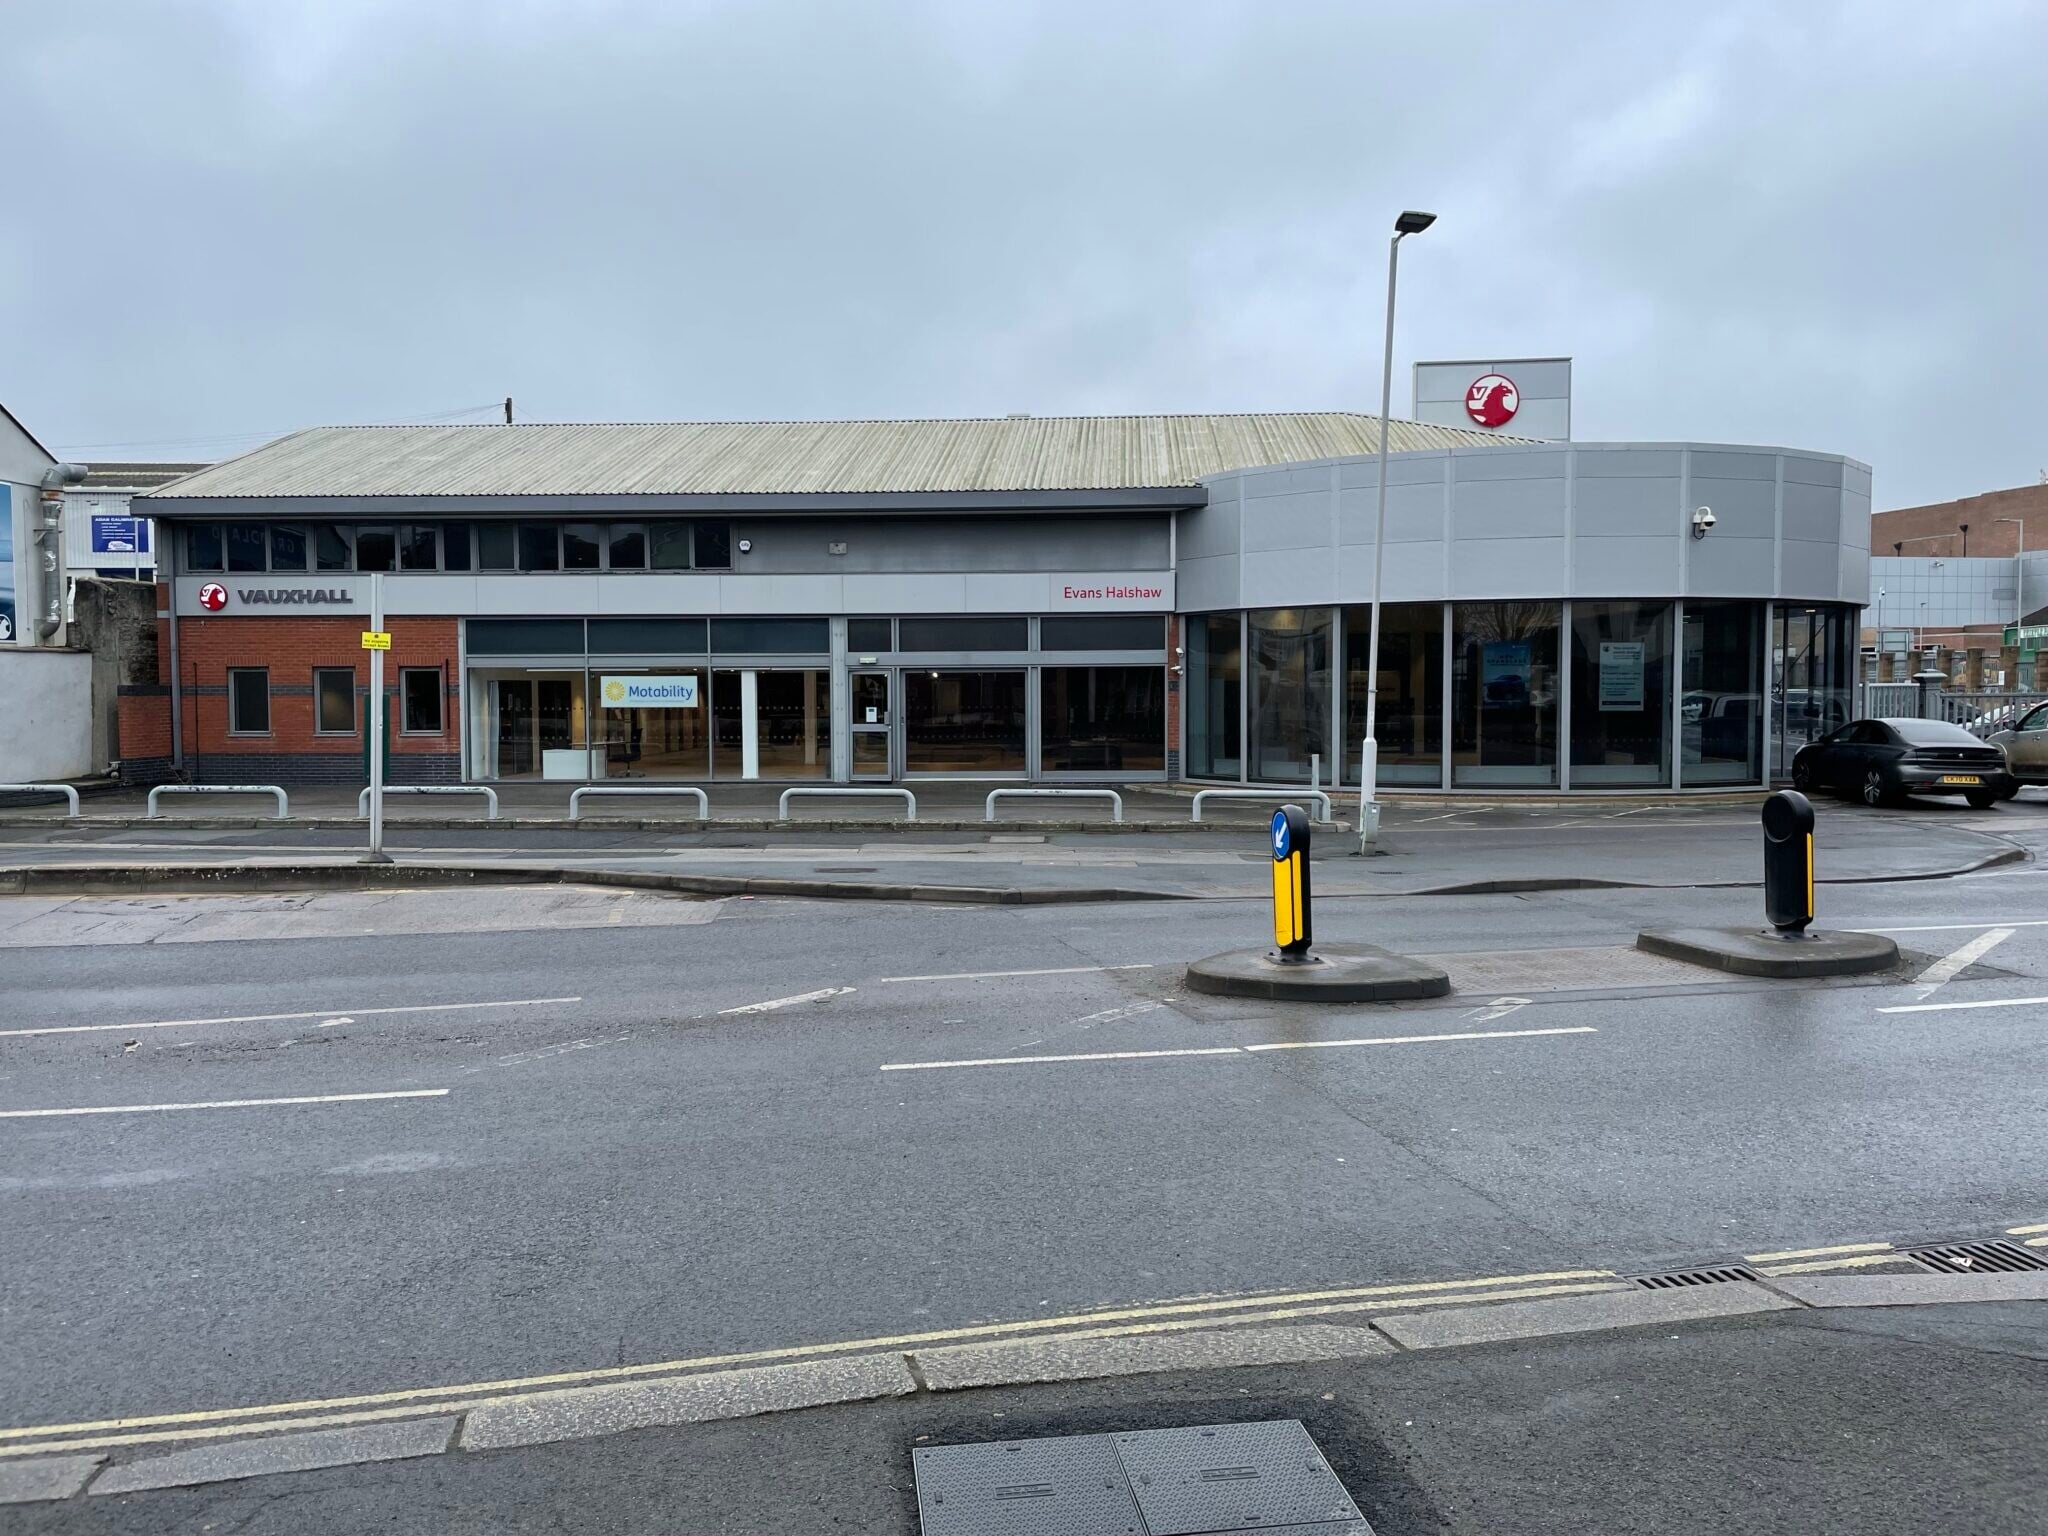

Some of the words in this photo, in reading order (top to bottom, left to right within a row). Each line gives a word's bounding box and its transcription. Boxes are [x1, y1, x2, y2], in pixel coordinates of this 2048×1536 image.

[238, 589, 353, 604] VAUXHALL
[1064, 586, 1102, 598] Evans
[1106, 586, 1162, 598] Halshaw
[629, 685, 693, 701] Motability
